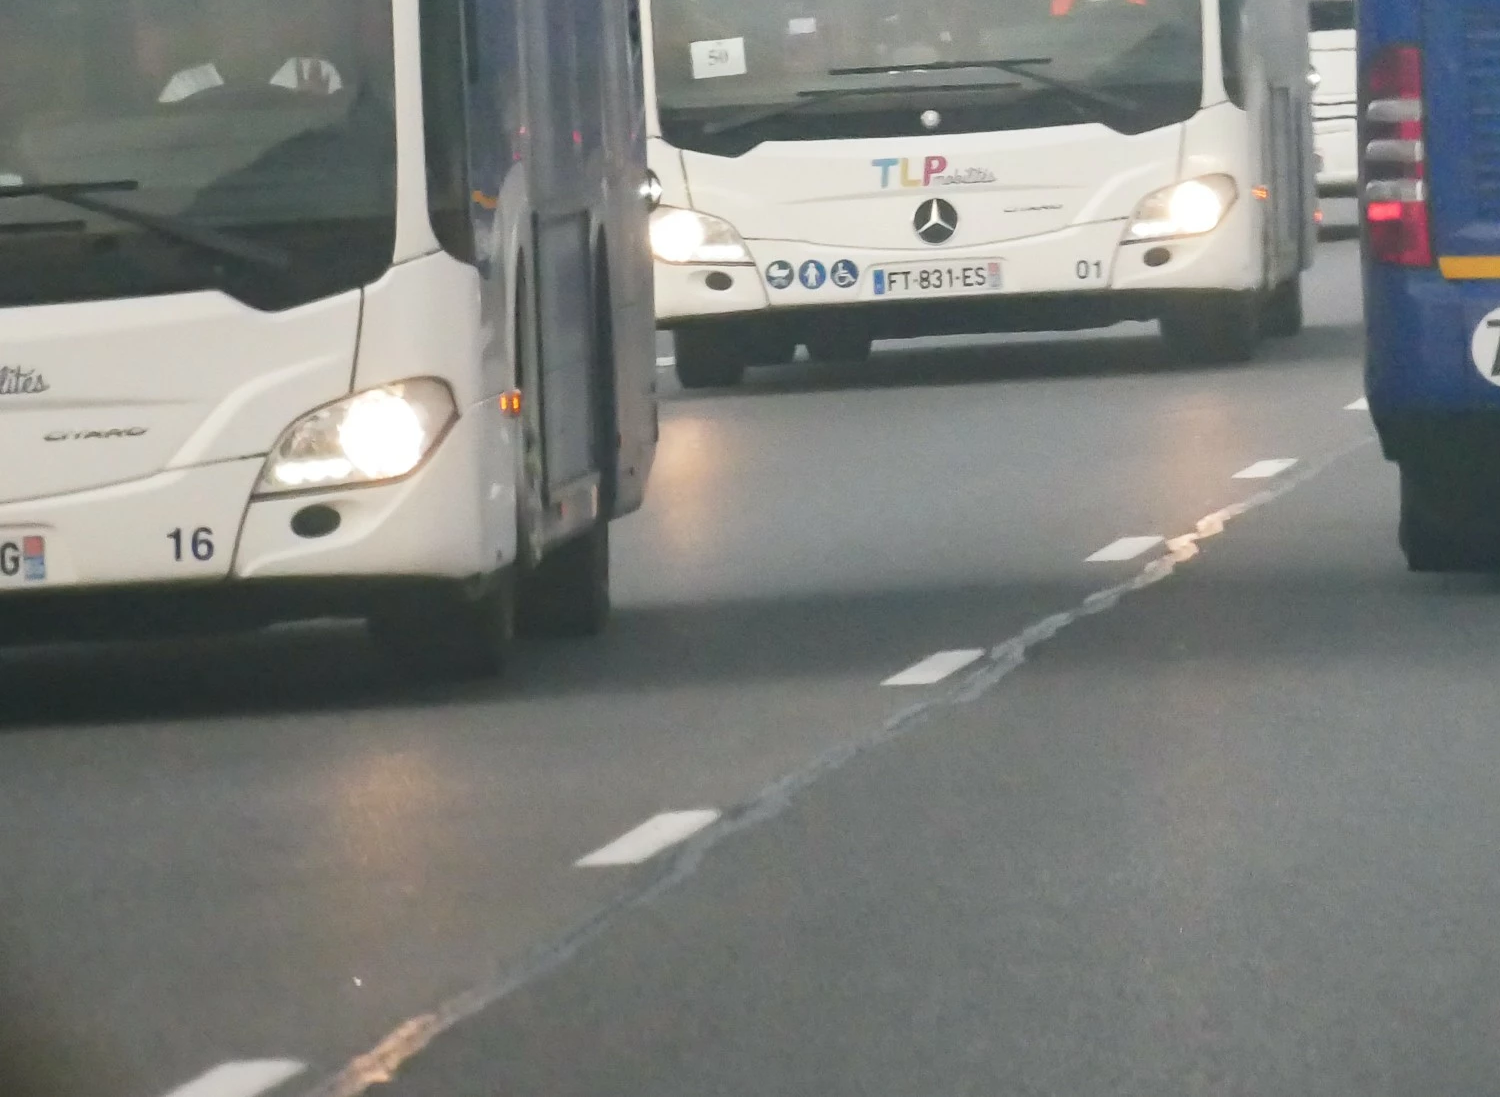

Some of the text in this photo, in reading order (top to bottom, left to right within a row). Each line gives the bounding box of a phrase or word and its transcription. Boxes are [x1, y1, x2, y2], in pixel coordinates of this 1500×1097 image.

[871, 155, 947, 188] TLP
[886, 266, 987, 292] FT-831-ES
[1076, 258, 1102, 280] 01
[166, 526, 215, 562] 16
